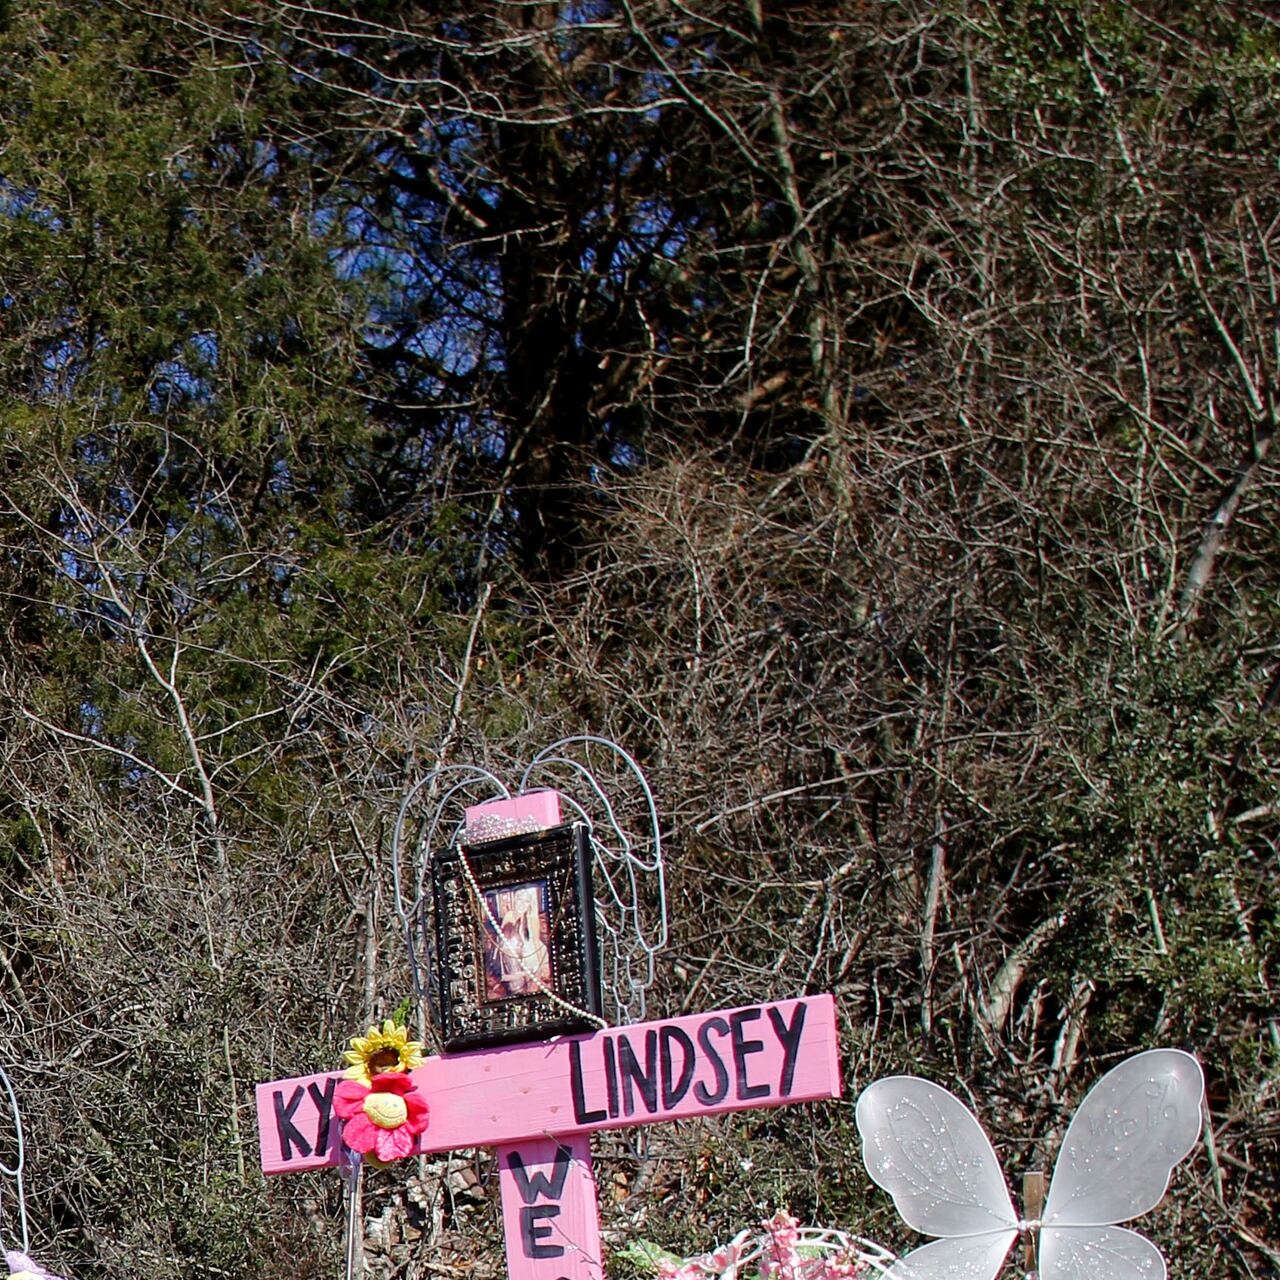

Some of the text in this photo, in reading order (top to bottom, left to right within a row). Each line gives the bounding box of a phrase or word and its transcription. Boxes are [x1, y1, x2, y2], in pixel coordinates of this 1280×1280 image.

[272, 1077, 336, 1161] KY
[569, 1002, 807, 1125] LINDSEY
[506, 1144, 574, 1260] WE
